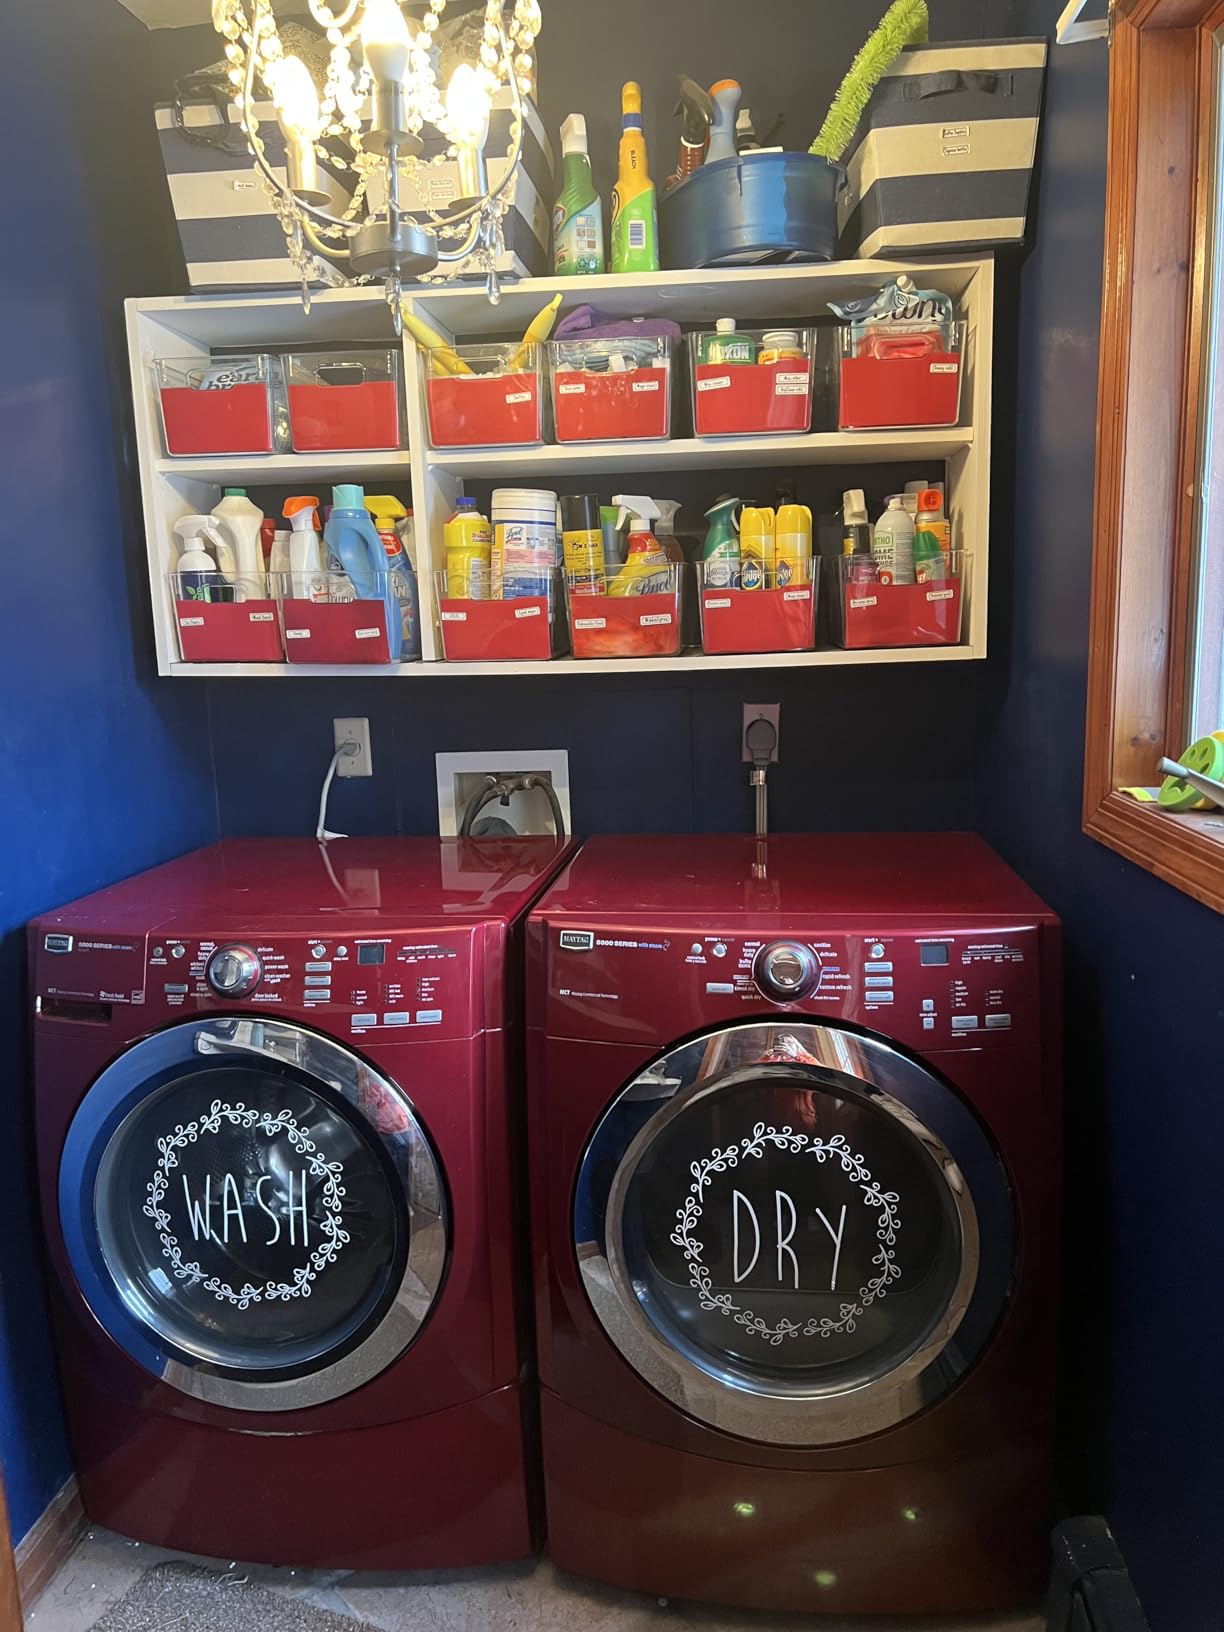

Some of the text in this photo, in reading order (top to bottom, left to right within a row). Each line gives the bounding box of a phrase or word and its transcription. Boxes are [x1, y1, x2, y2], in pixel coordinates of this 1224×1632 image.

[563, 935, 589, 944] MAYTAG
[614, 940, 638, 948] SERIES
[182, 1169, 309, 1248] WASH
[732, 1189, 847, 1291] DRY
